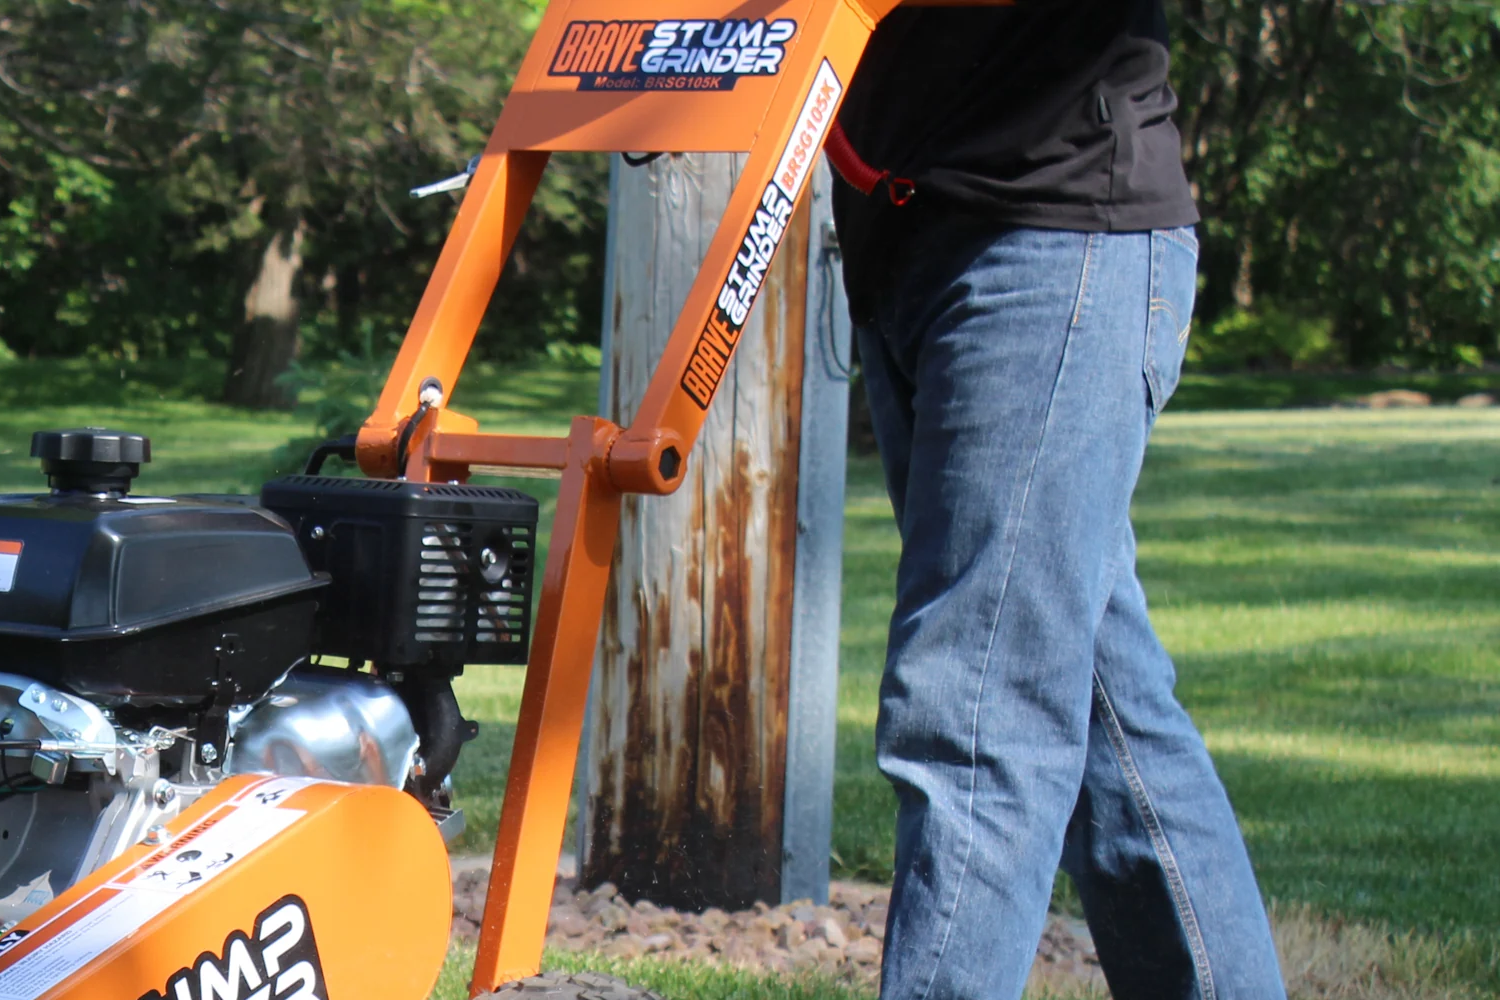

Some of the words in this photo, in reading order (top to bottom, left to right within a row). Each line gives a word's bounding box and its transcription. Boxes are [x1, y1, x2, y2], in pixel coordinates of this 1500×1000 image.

[552, 22, 649, 73] BRAVE
[640, 47, 783, 74] GRINDER
[648, 20, 795, 48] STUMP
[594, 76, 639, 89] Model:
[644, 76, 722, 89] BRSG105K
[781, 77, 836, 192] BRSG105K
[718, 183, 779, 316] STUMP
[731, 197, 793, 326] GRINDER
[685, 310, 739, 406] BRAVE
